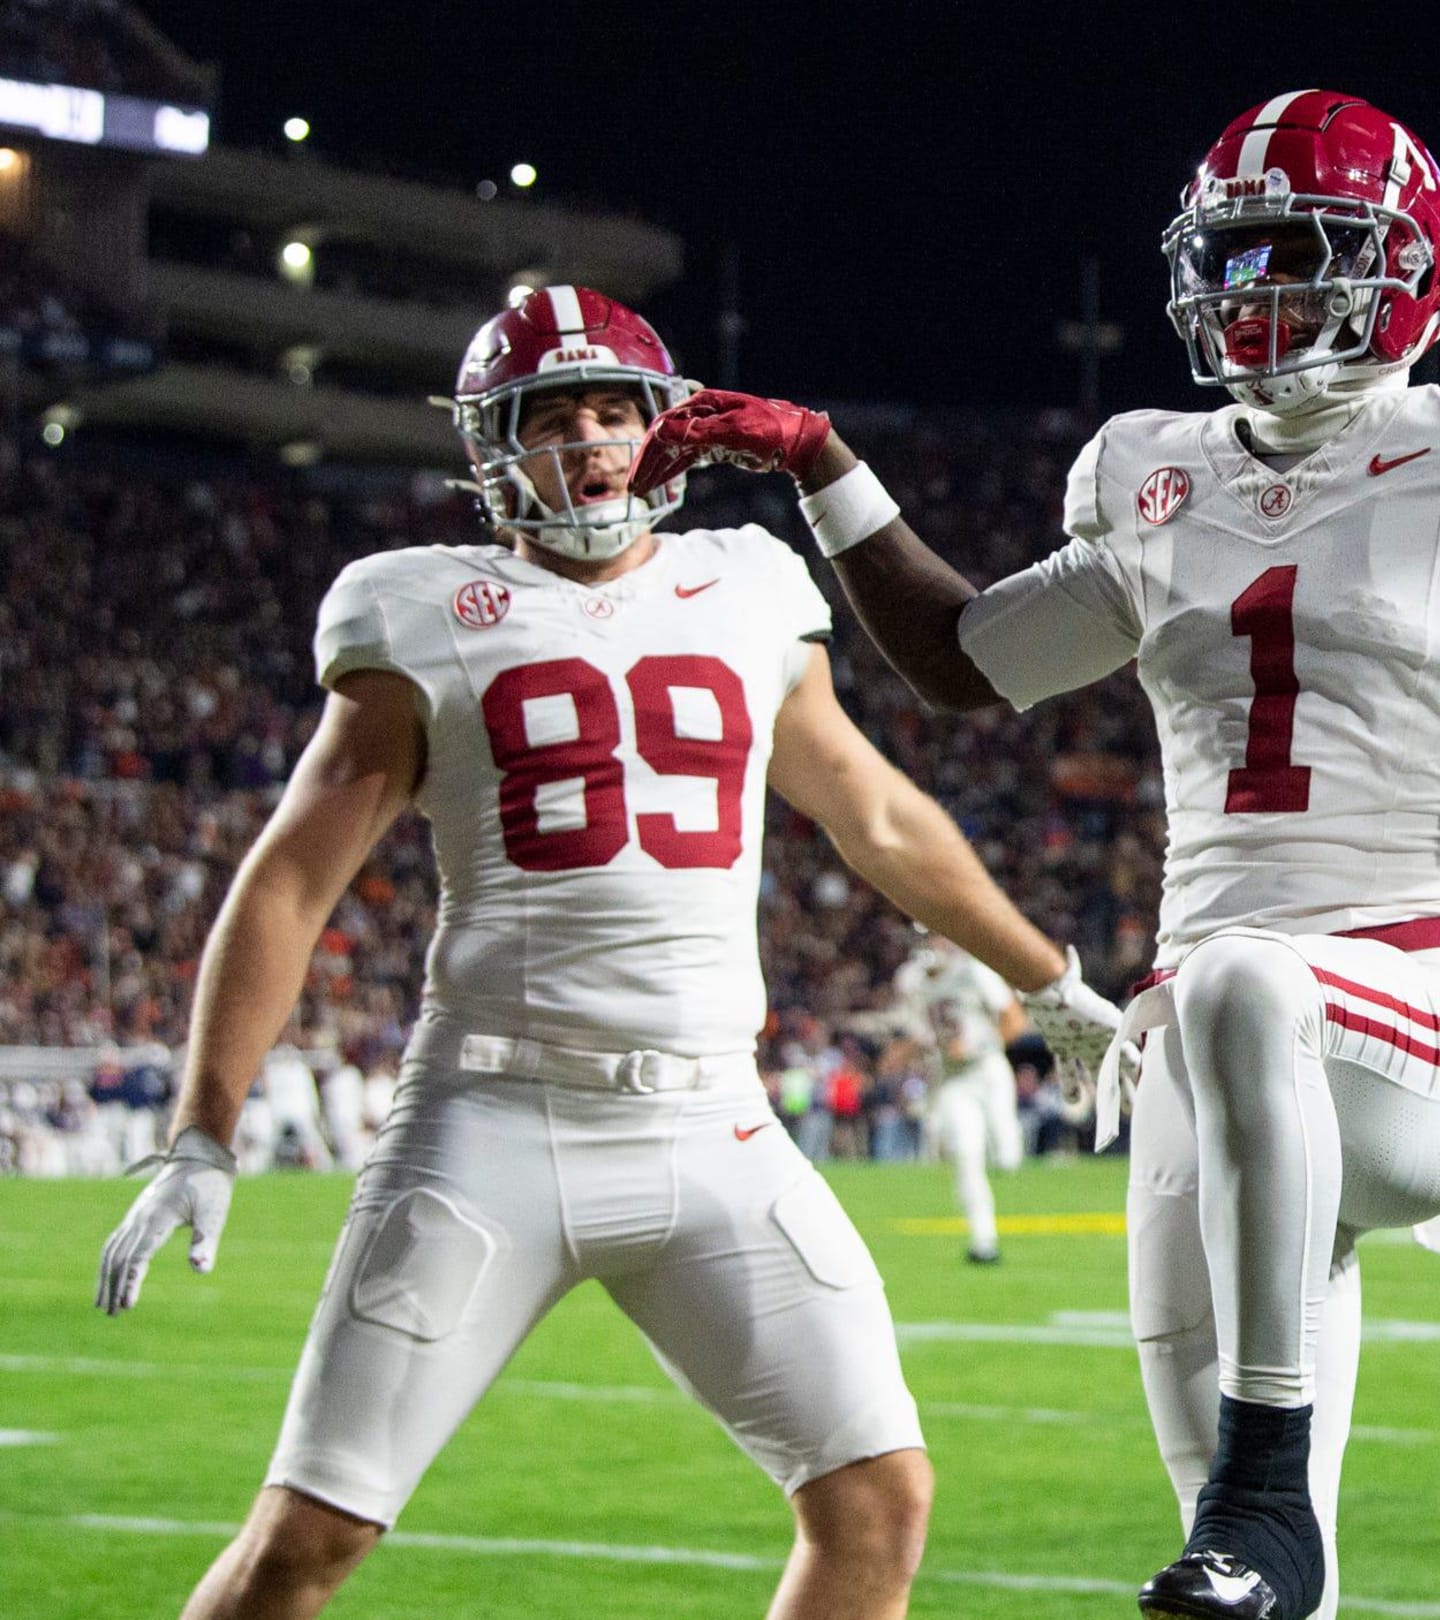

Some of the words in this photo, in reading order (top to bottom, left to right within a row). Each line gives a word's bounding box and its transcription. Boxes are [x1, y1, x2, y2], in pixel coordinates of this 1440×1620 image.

[555, 348, 598, 363] BAMA
[1139, 467, 1190, 525] SEC
[456, 580, 511, 629] SEC
[1224, 564, 1312, 813] 1
[481, 654, 753, 872] 89
